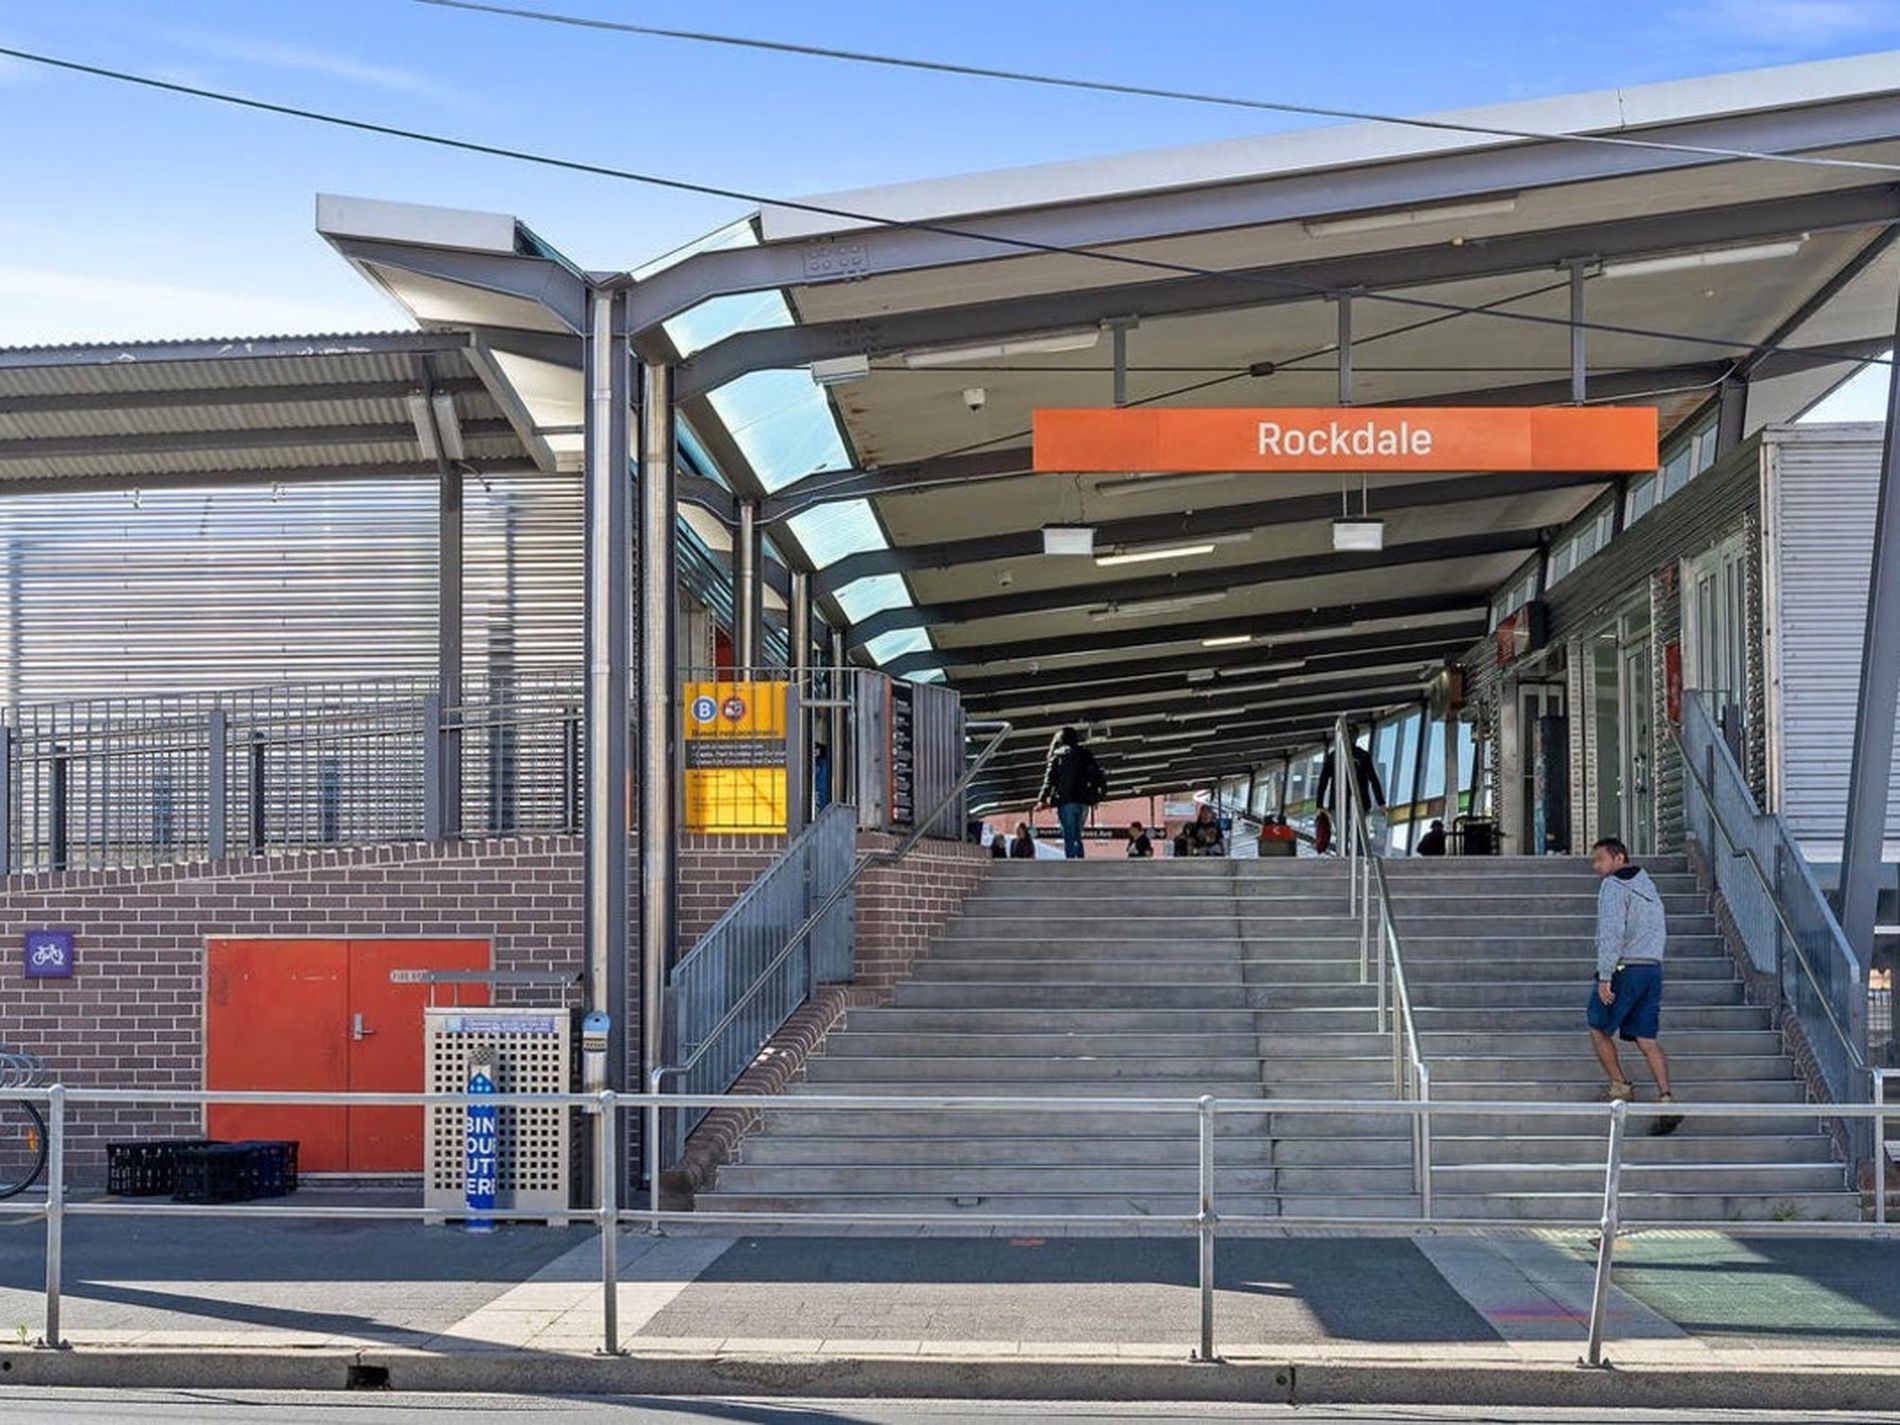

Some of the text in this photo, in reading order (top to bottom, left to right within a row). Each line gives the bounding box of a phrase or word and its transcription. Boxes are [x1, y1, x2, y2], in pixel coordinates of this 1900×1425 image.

[1257, 421, 1433, 456] Rockdale
[699, 701, 711, 718] B
[466, 1116, 494, 1133] BIN
